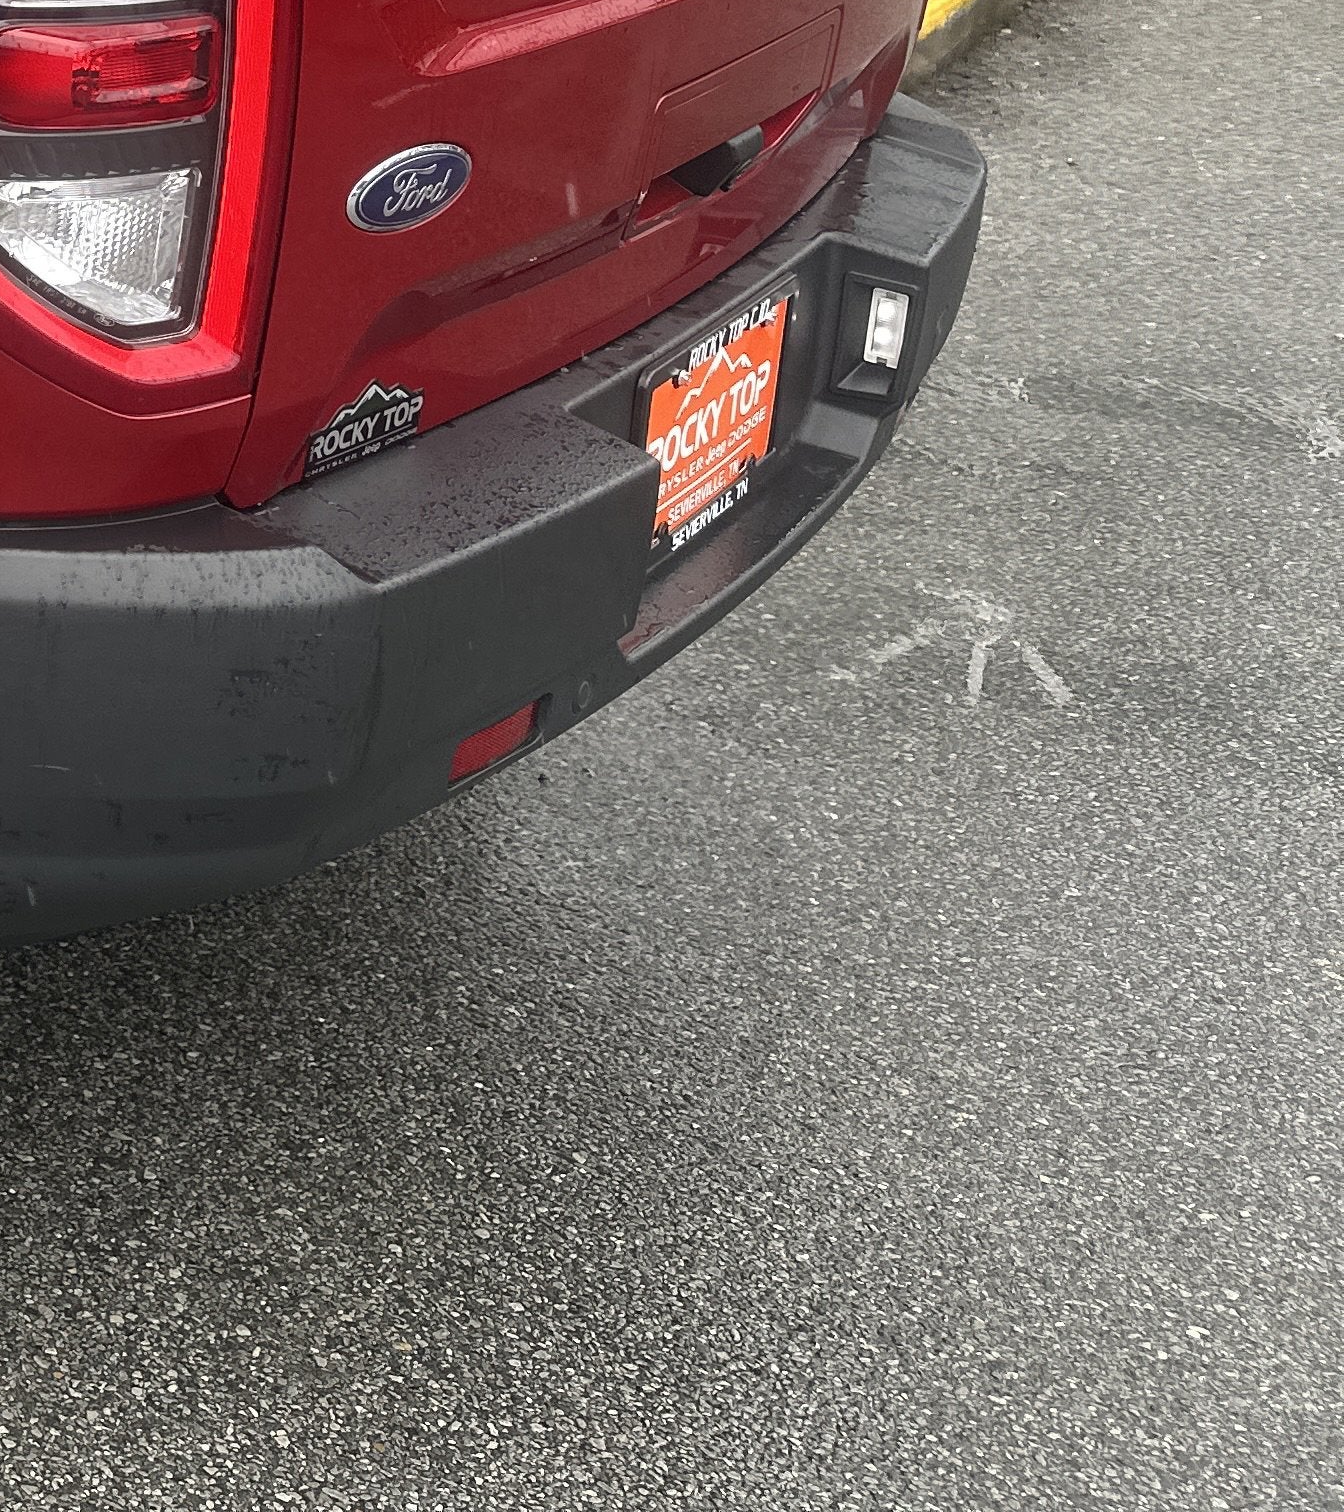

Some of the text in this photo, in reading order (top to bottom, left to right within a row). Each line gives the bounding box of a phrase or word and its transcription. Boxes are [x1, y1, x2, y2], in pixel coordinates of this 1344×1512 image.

[382, 163, 452, 217] Ford
[728, 312, 750, 346] TOP
[729, 359, 771, 425] TOP
[309, 395, 424, 464] ROCKY TOP
[658, 455, 706, 500] RYSLER
[671, 476, 749, 552] SEVIERVILLE, TN
